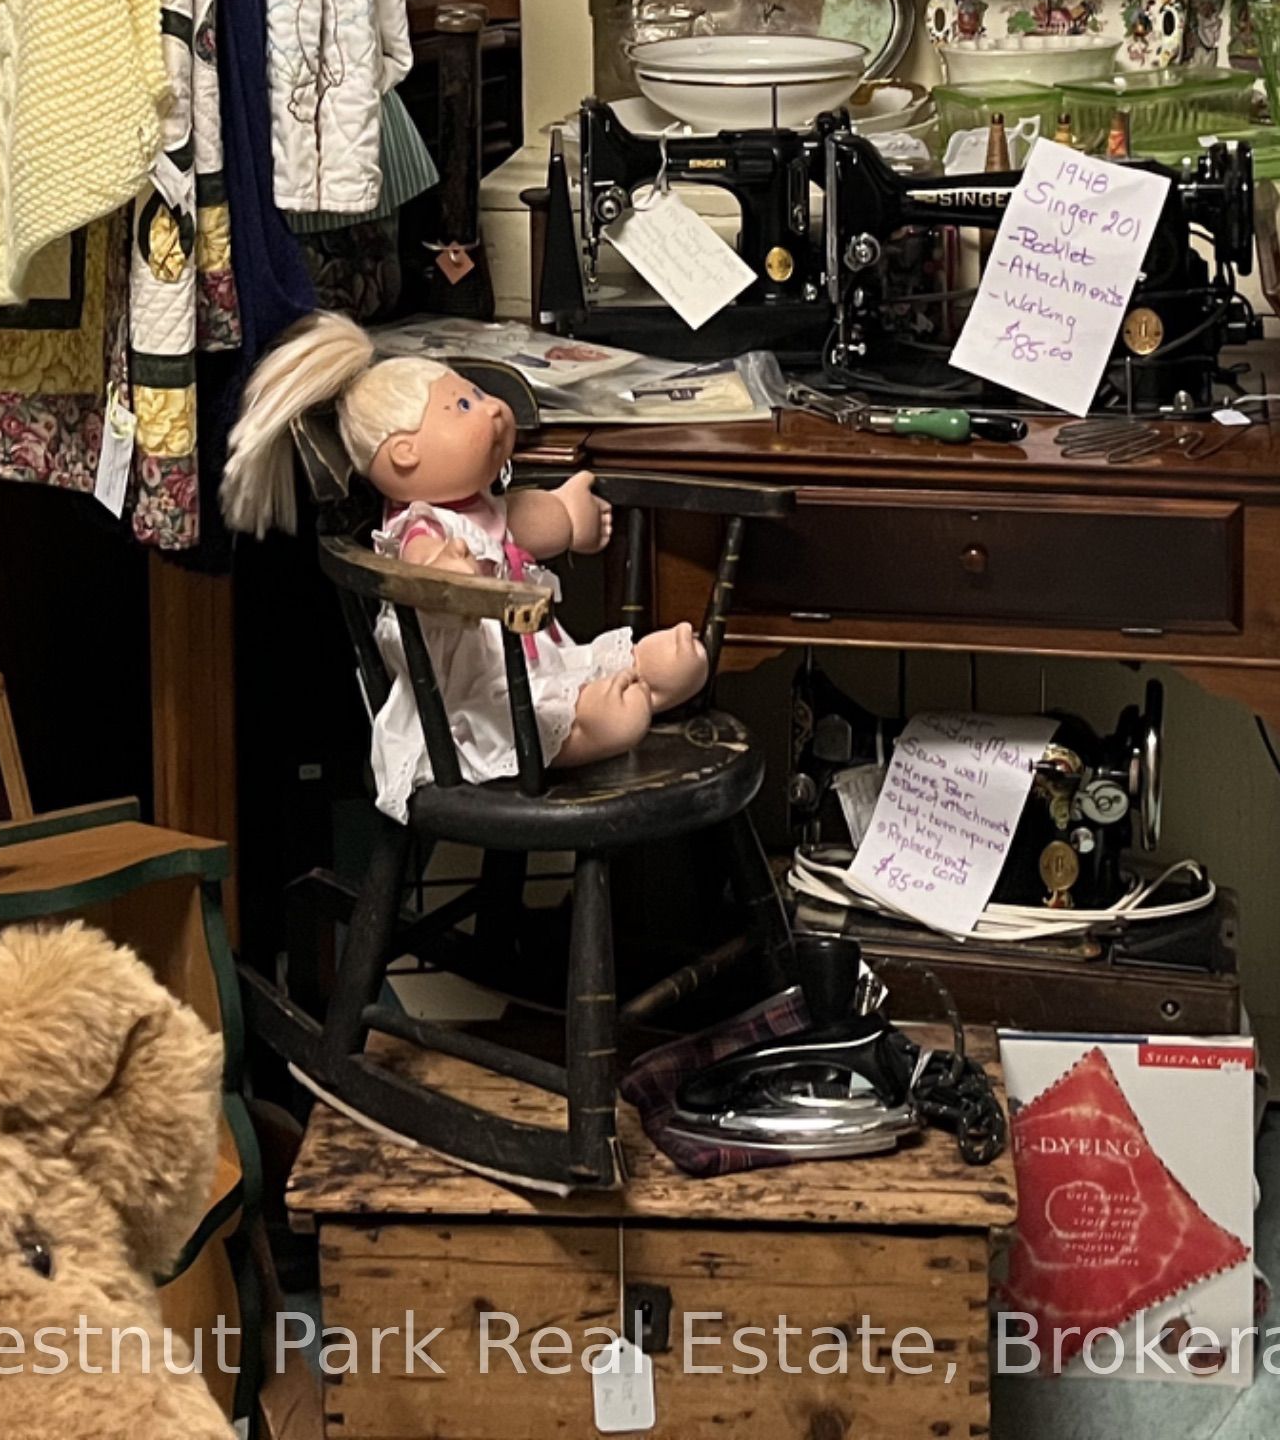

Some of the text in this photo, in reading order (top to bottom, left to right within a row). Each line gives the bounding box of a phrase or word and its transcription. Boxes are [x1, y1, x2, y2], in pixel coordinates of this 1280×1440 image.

[1056, 160, 1109, 193] 1948
[940, 190, 1009, 208] SINGE
[1024, 181, 1141, 242] Singer 201
